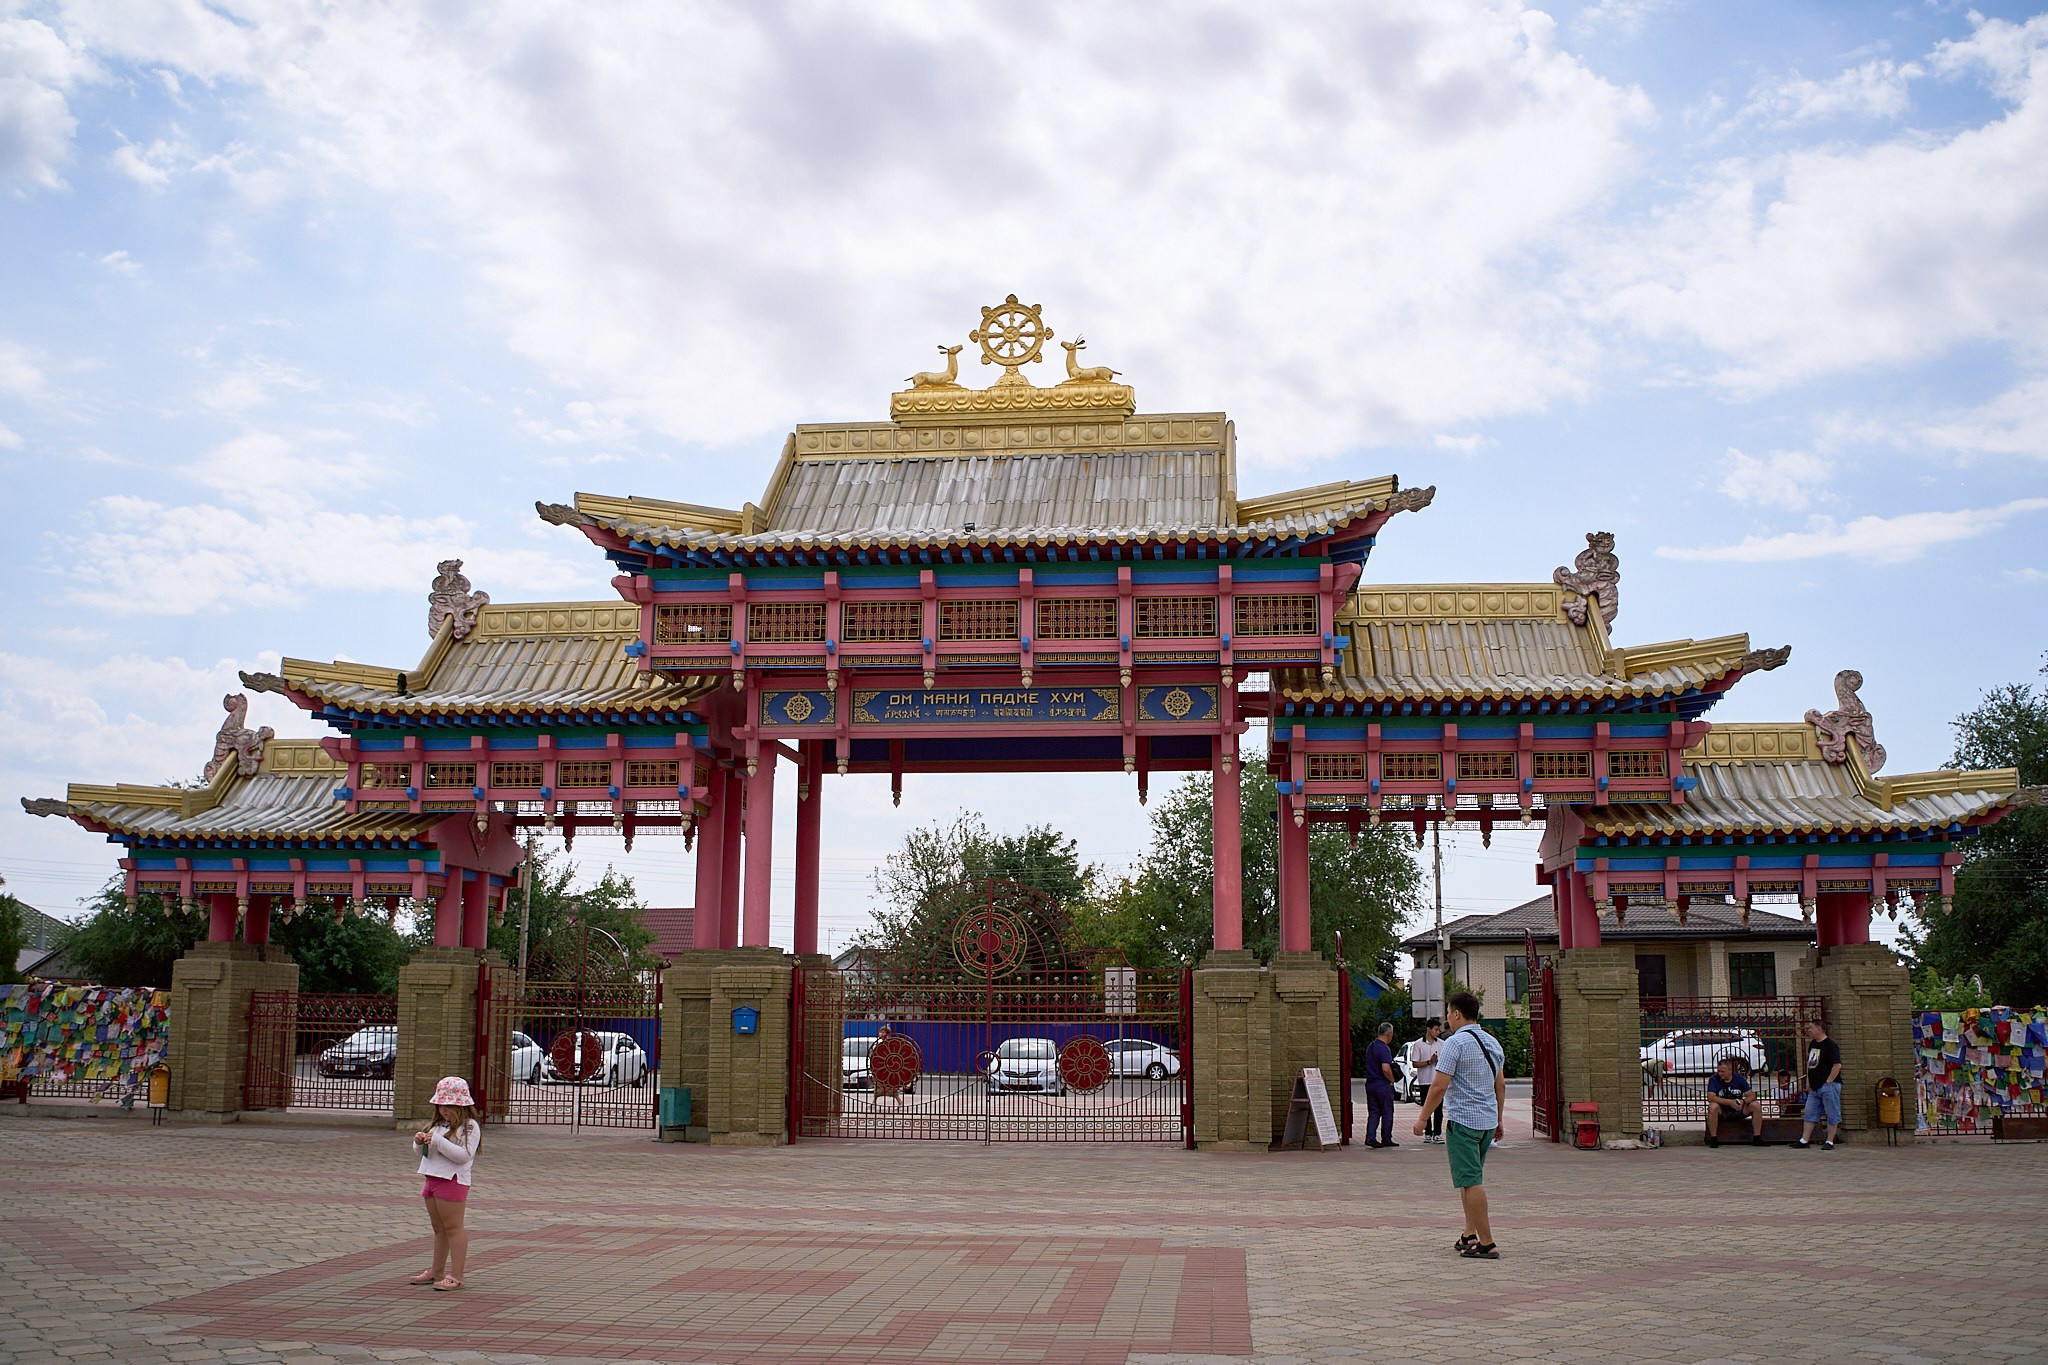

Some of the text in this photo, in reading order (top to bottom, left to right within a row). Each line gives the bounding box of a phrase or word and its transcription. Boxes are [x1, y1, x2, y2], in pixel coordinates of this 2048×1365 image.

[889, 692, 1085, 706] ОМ МАНИ ПАДМЕ ХУМ
